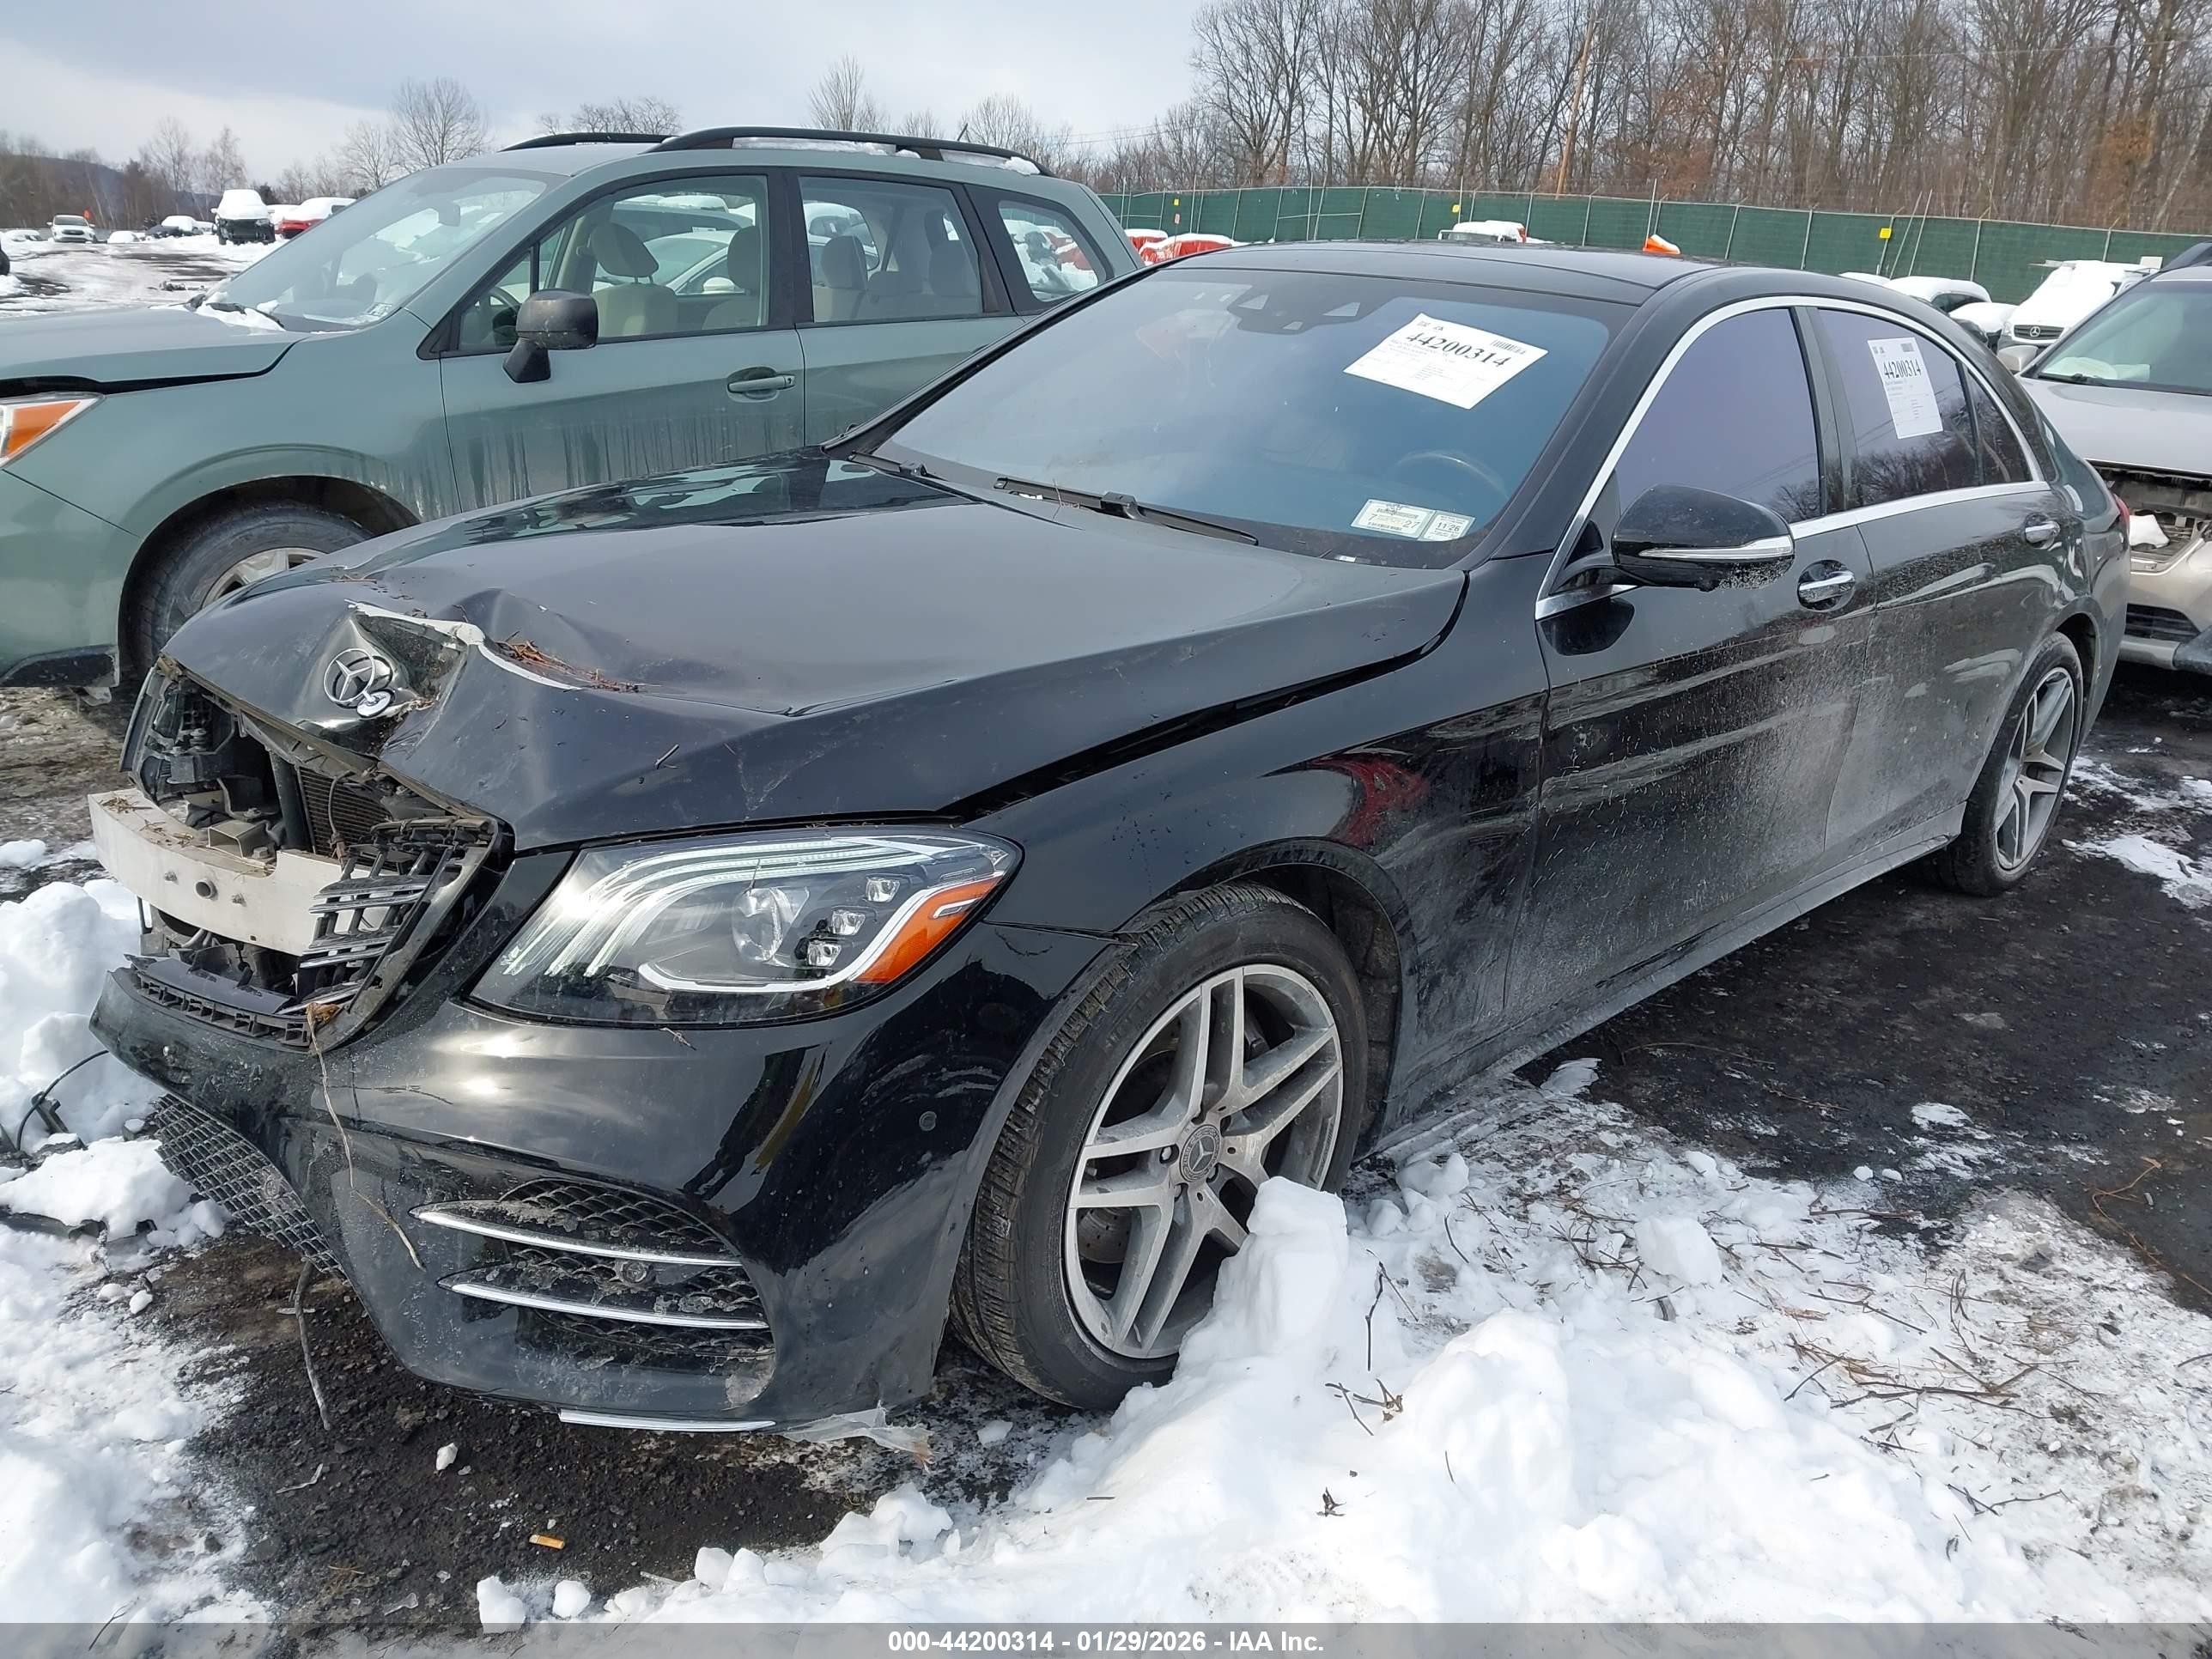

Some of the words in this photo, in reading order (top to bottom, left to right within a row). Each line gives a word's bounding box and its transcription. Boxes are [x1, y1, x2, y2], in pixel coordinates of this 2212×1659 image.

[1407, 332, 1511, 368] 44200314
[1883, 359, 1922, 379] 44200314
[1402, 520, 1421, 529] 27
